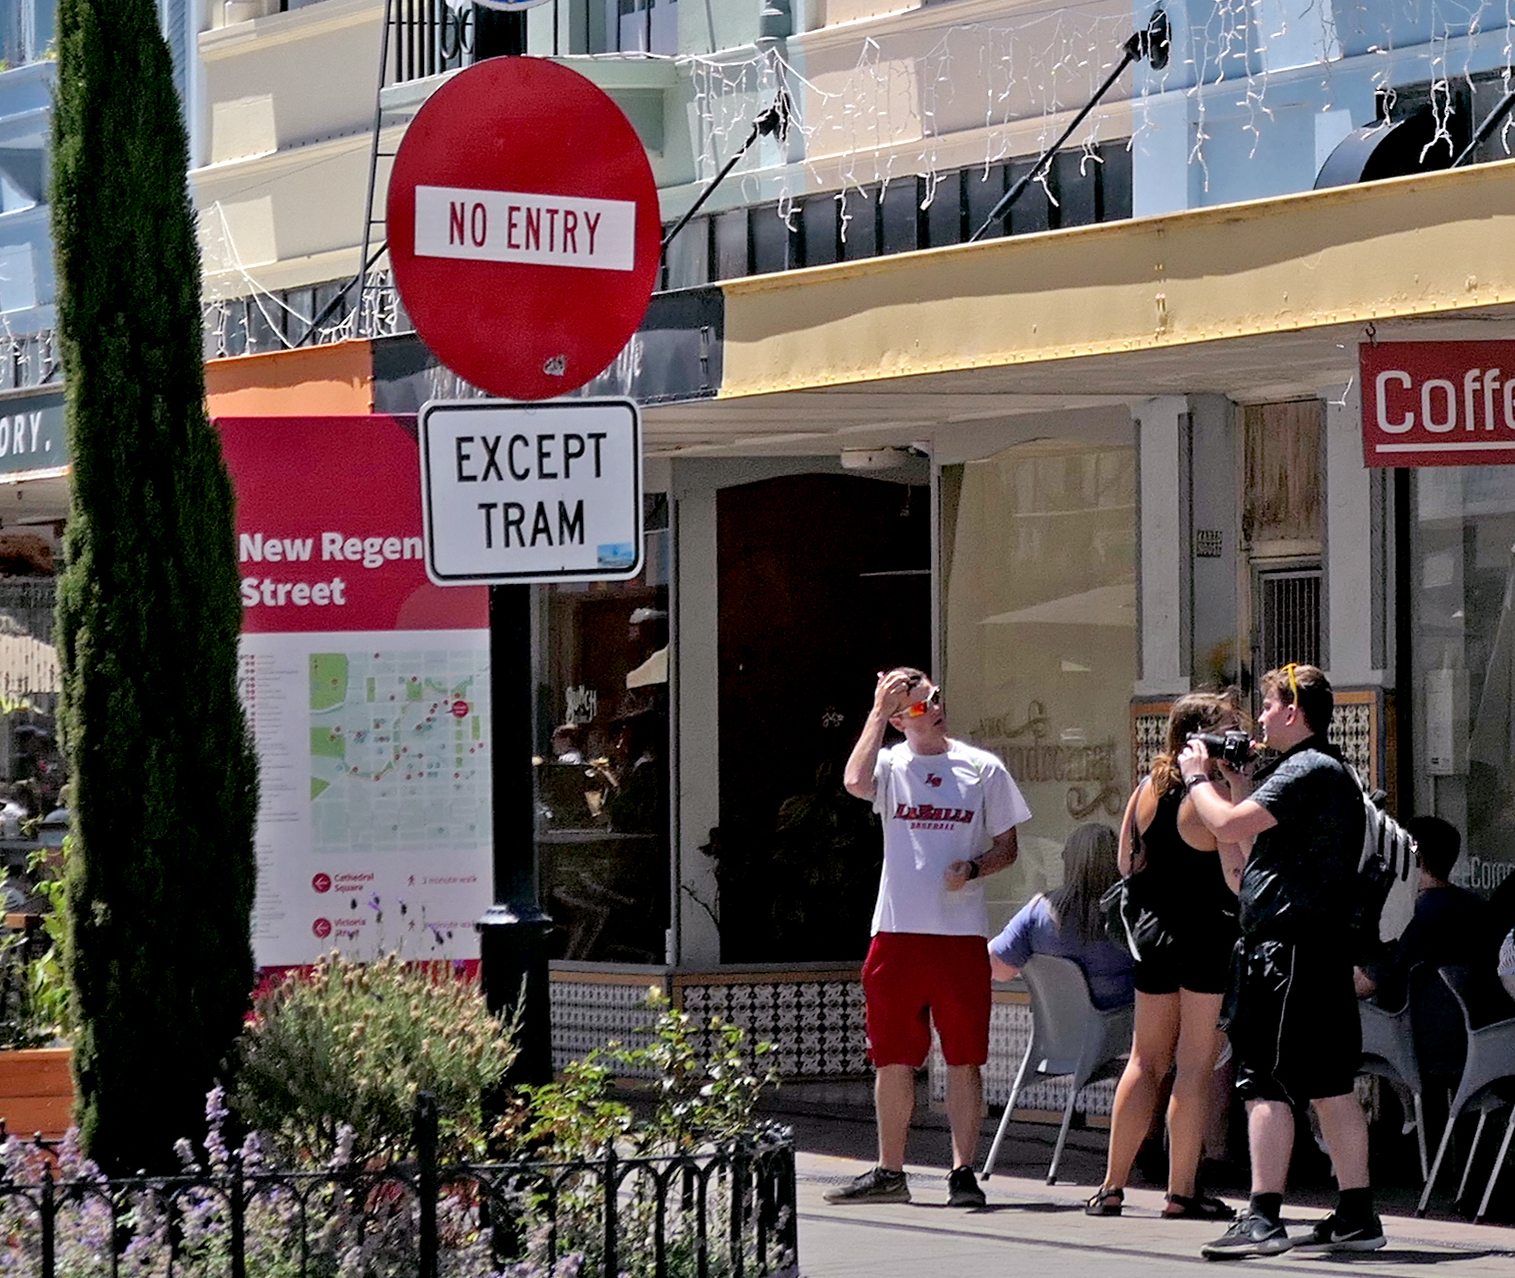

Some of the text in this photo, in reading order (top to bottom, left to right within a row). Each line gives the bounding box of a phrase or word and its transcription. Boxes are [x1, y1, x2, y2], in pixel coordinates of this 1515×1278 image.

[448, 200, 603, 256] NO ENTRY
[454, 431, 607, 484] EXCEPT
[477, 499, 586, 550] TRAM
[238, 530, 423, 571] New Regen
[238, 576, 347, 608] Street
